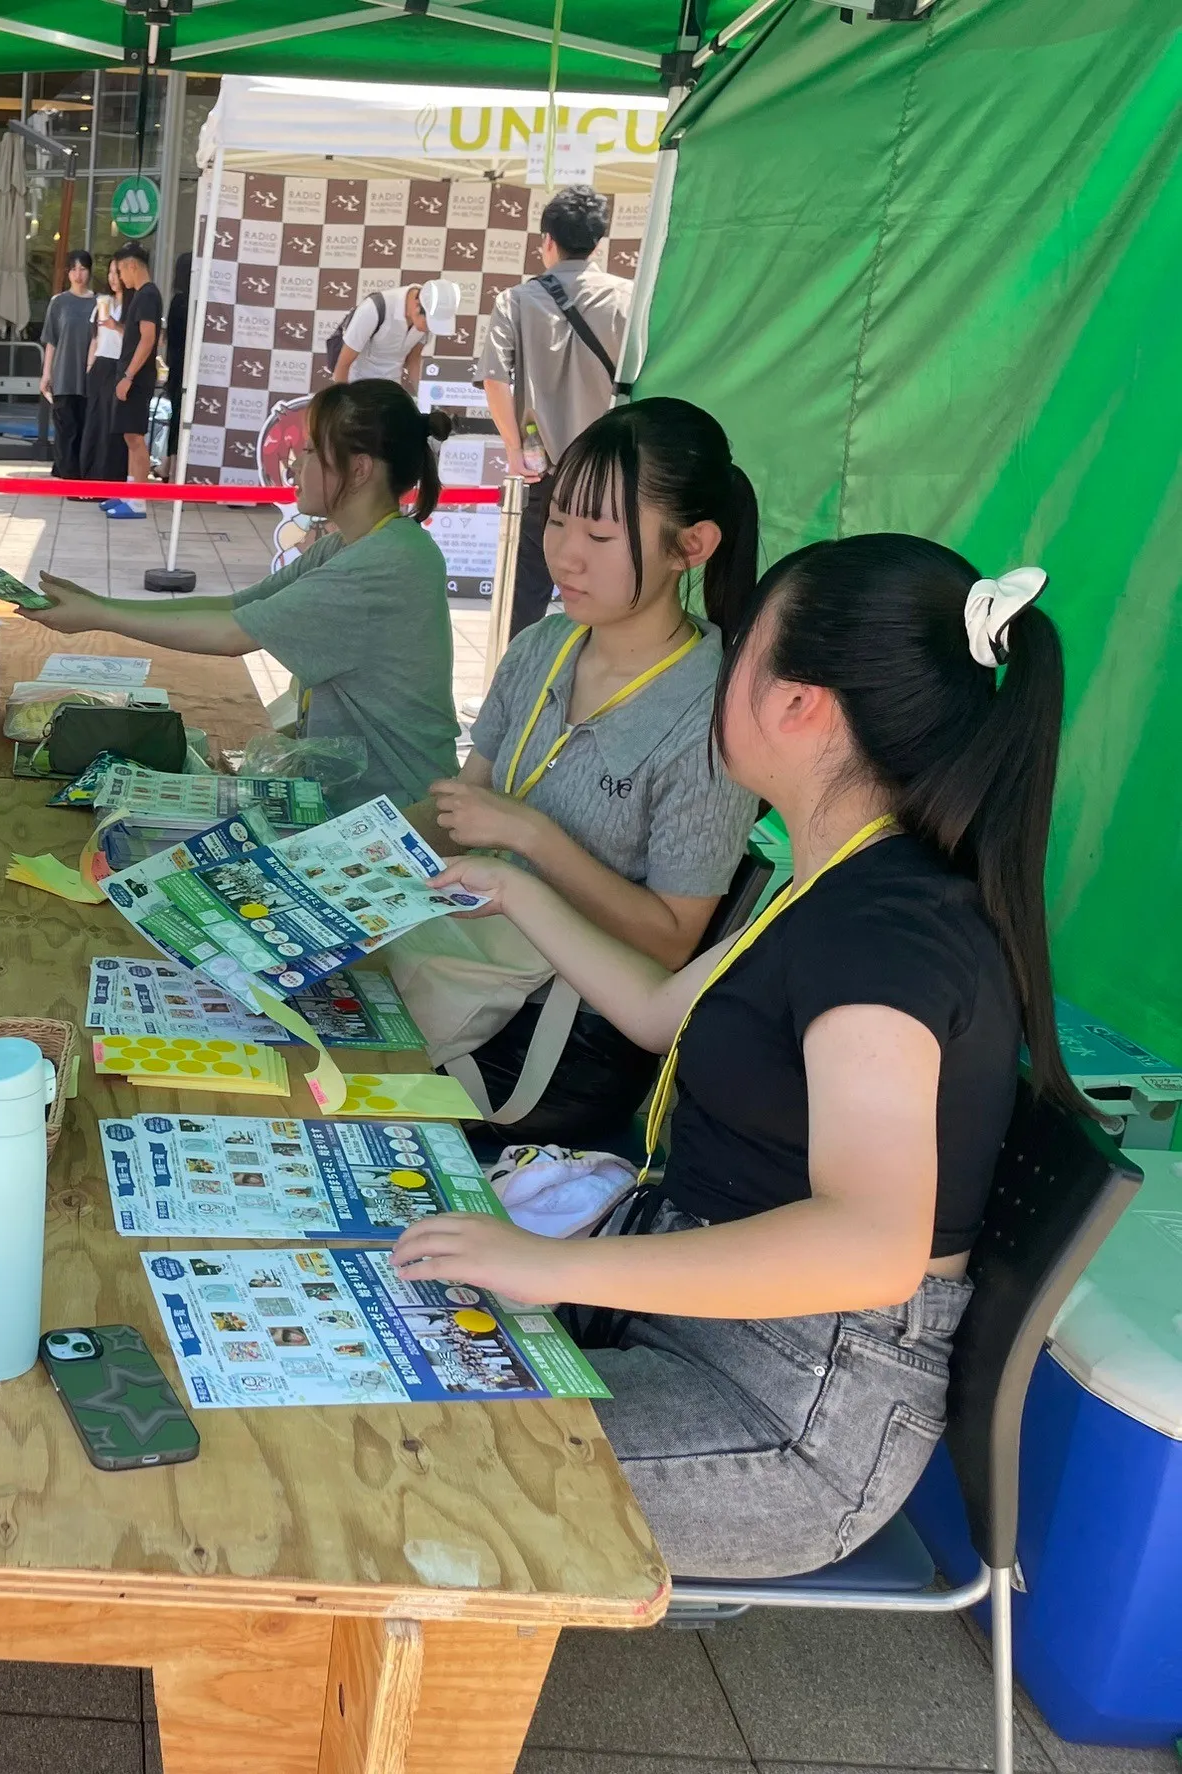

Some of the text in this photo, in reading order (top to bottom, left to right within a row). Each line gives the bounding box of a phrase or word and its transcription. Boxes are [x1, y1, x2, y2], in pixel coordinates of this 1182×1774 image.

[172, 1308, 195, 1338] 講座一覧
[339, 1259, 422, 1384] 第20回川越まちゼミ、始まります
[543, 1370, 562, 1386] LINE
